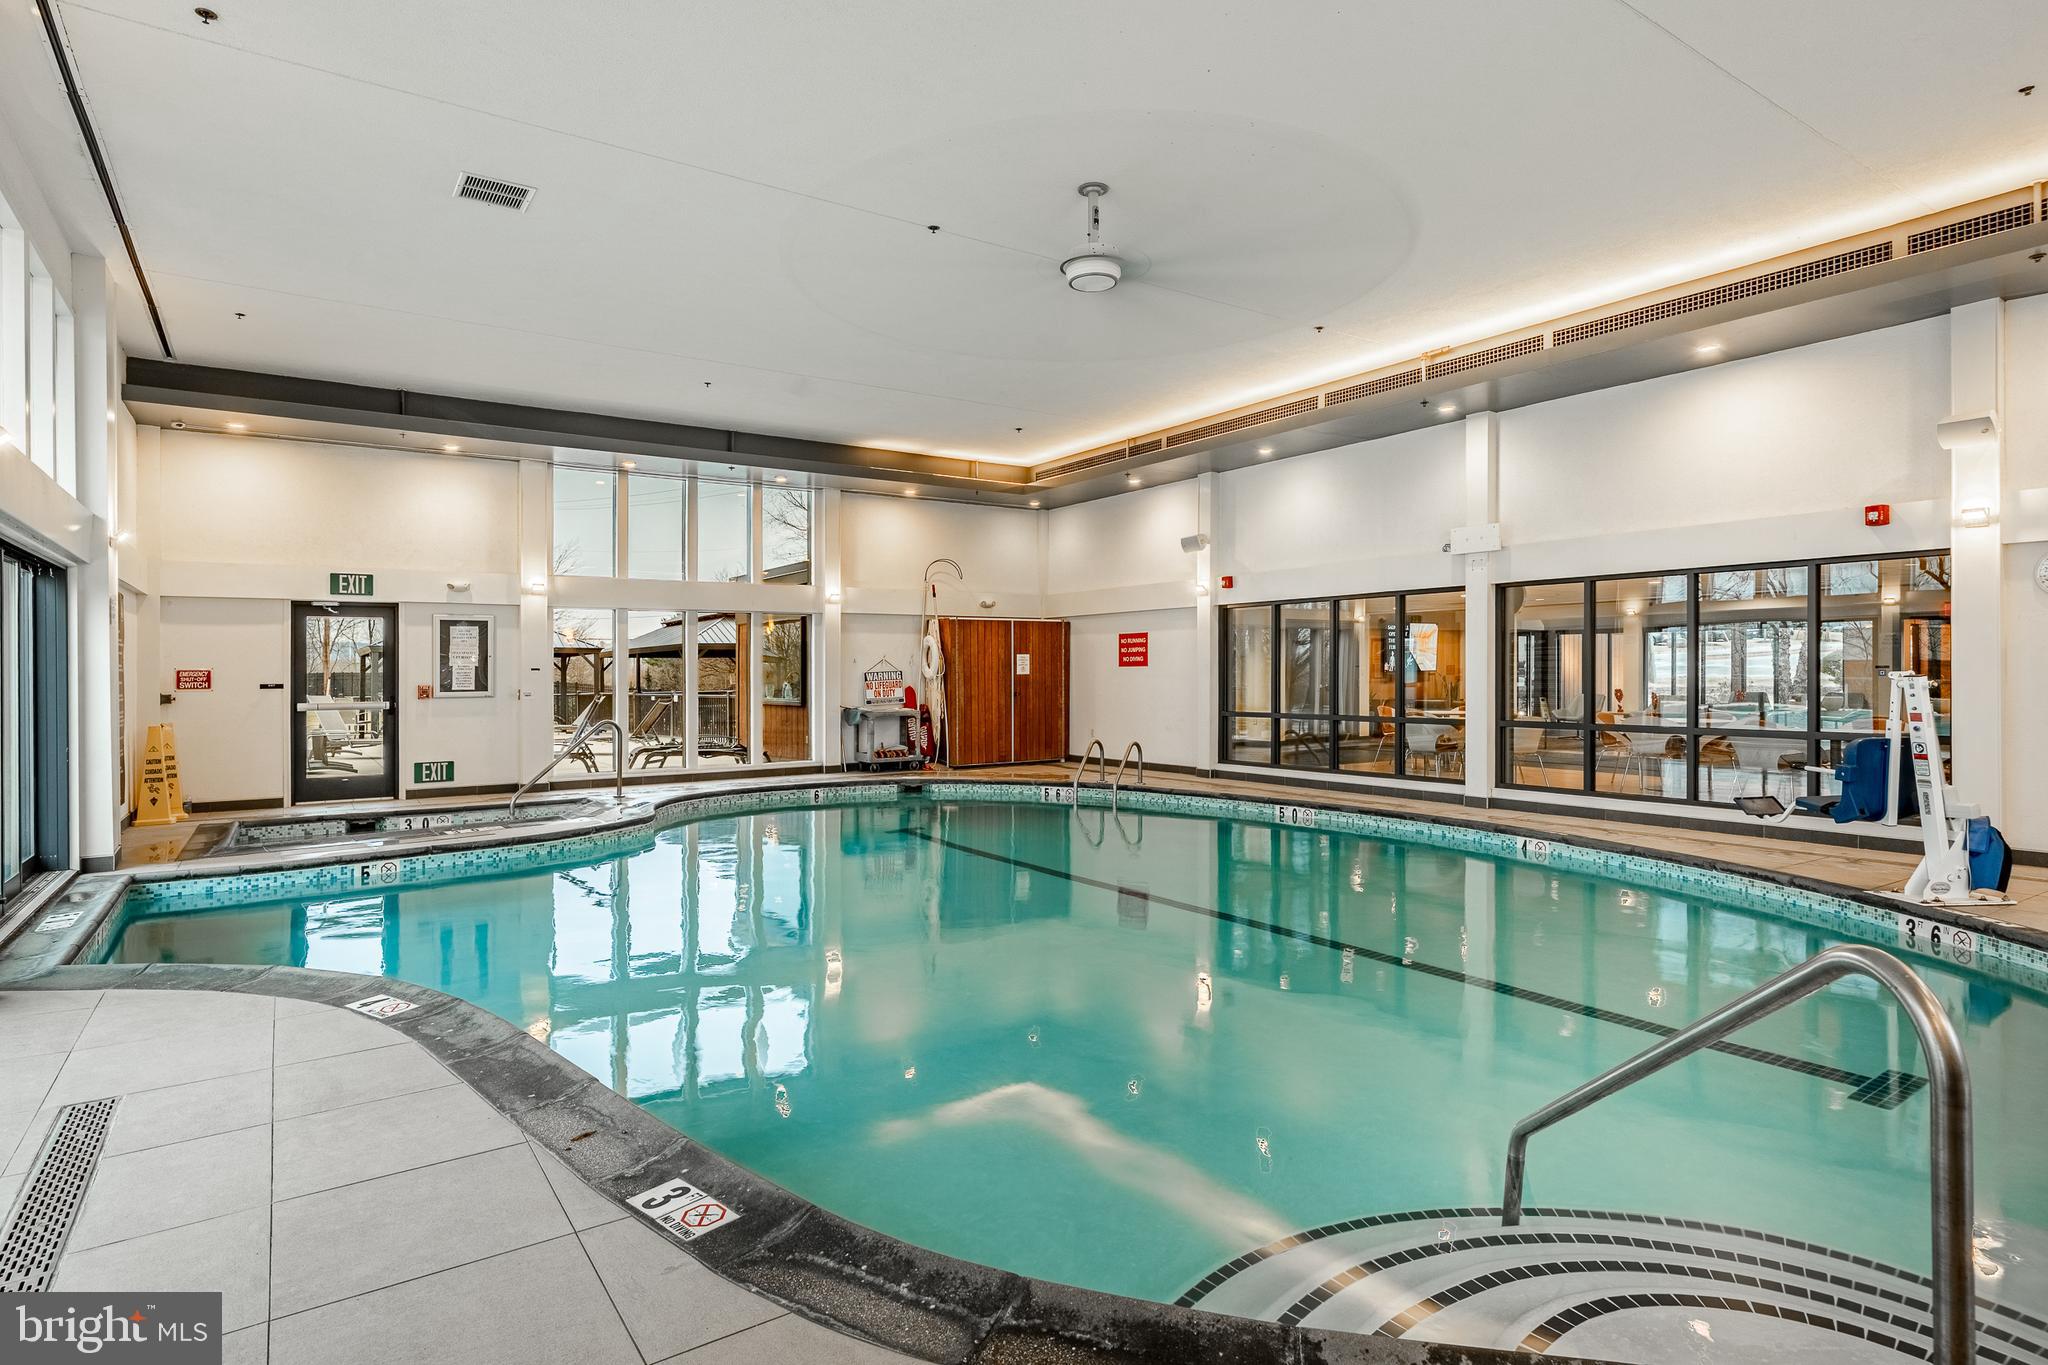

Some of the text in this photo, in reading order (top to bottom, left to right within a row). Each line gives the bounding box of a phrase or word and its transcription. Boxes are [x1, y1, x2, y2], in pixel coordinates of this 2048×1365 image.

[339, 574, 367, 594] EXIT
[866, 671, 901, 680] WARNING
[866, 680, 902, 690] NO LIFEGUARD
[874, 690, 881, 698] ON
[422, 762, 448, 782] EXIT
[405, 818, 413, 830] 3
[642, 1187, 691, 1209] 3
[660, 1215, 696, 1239] NO DIVING
